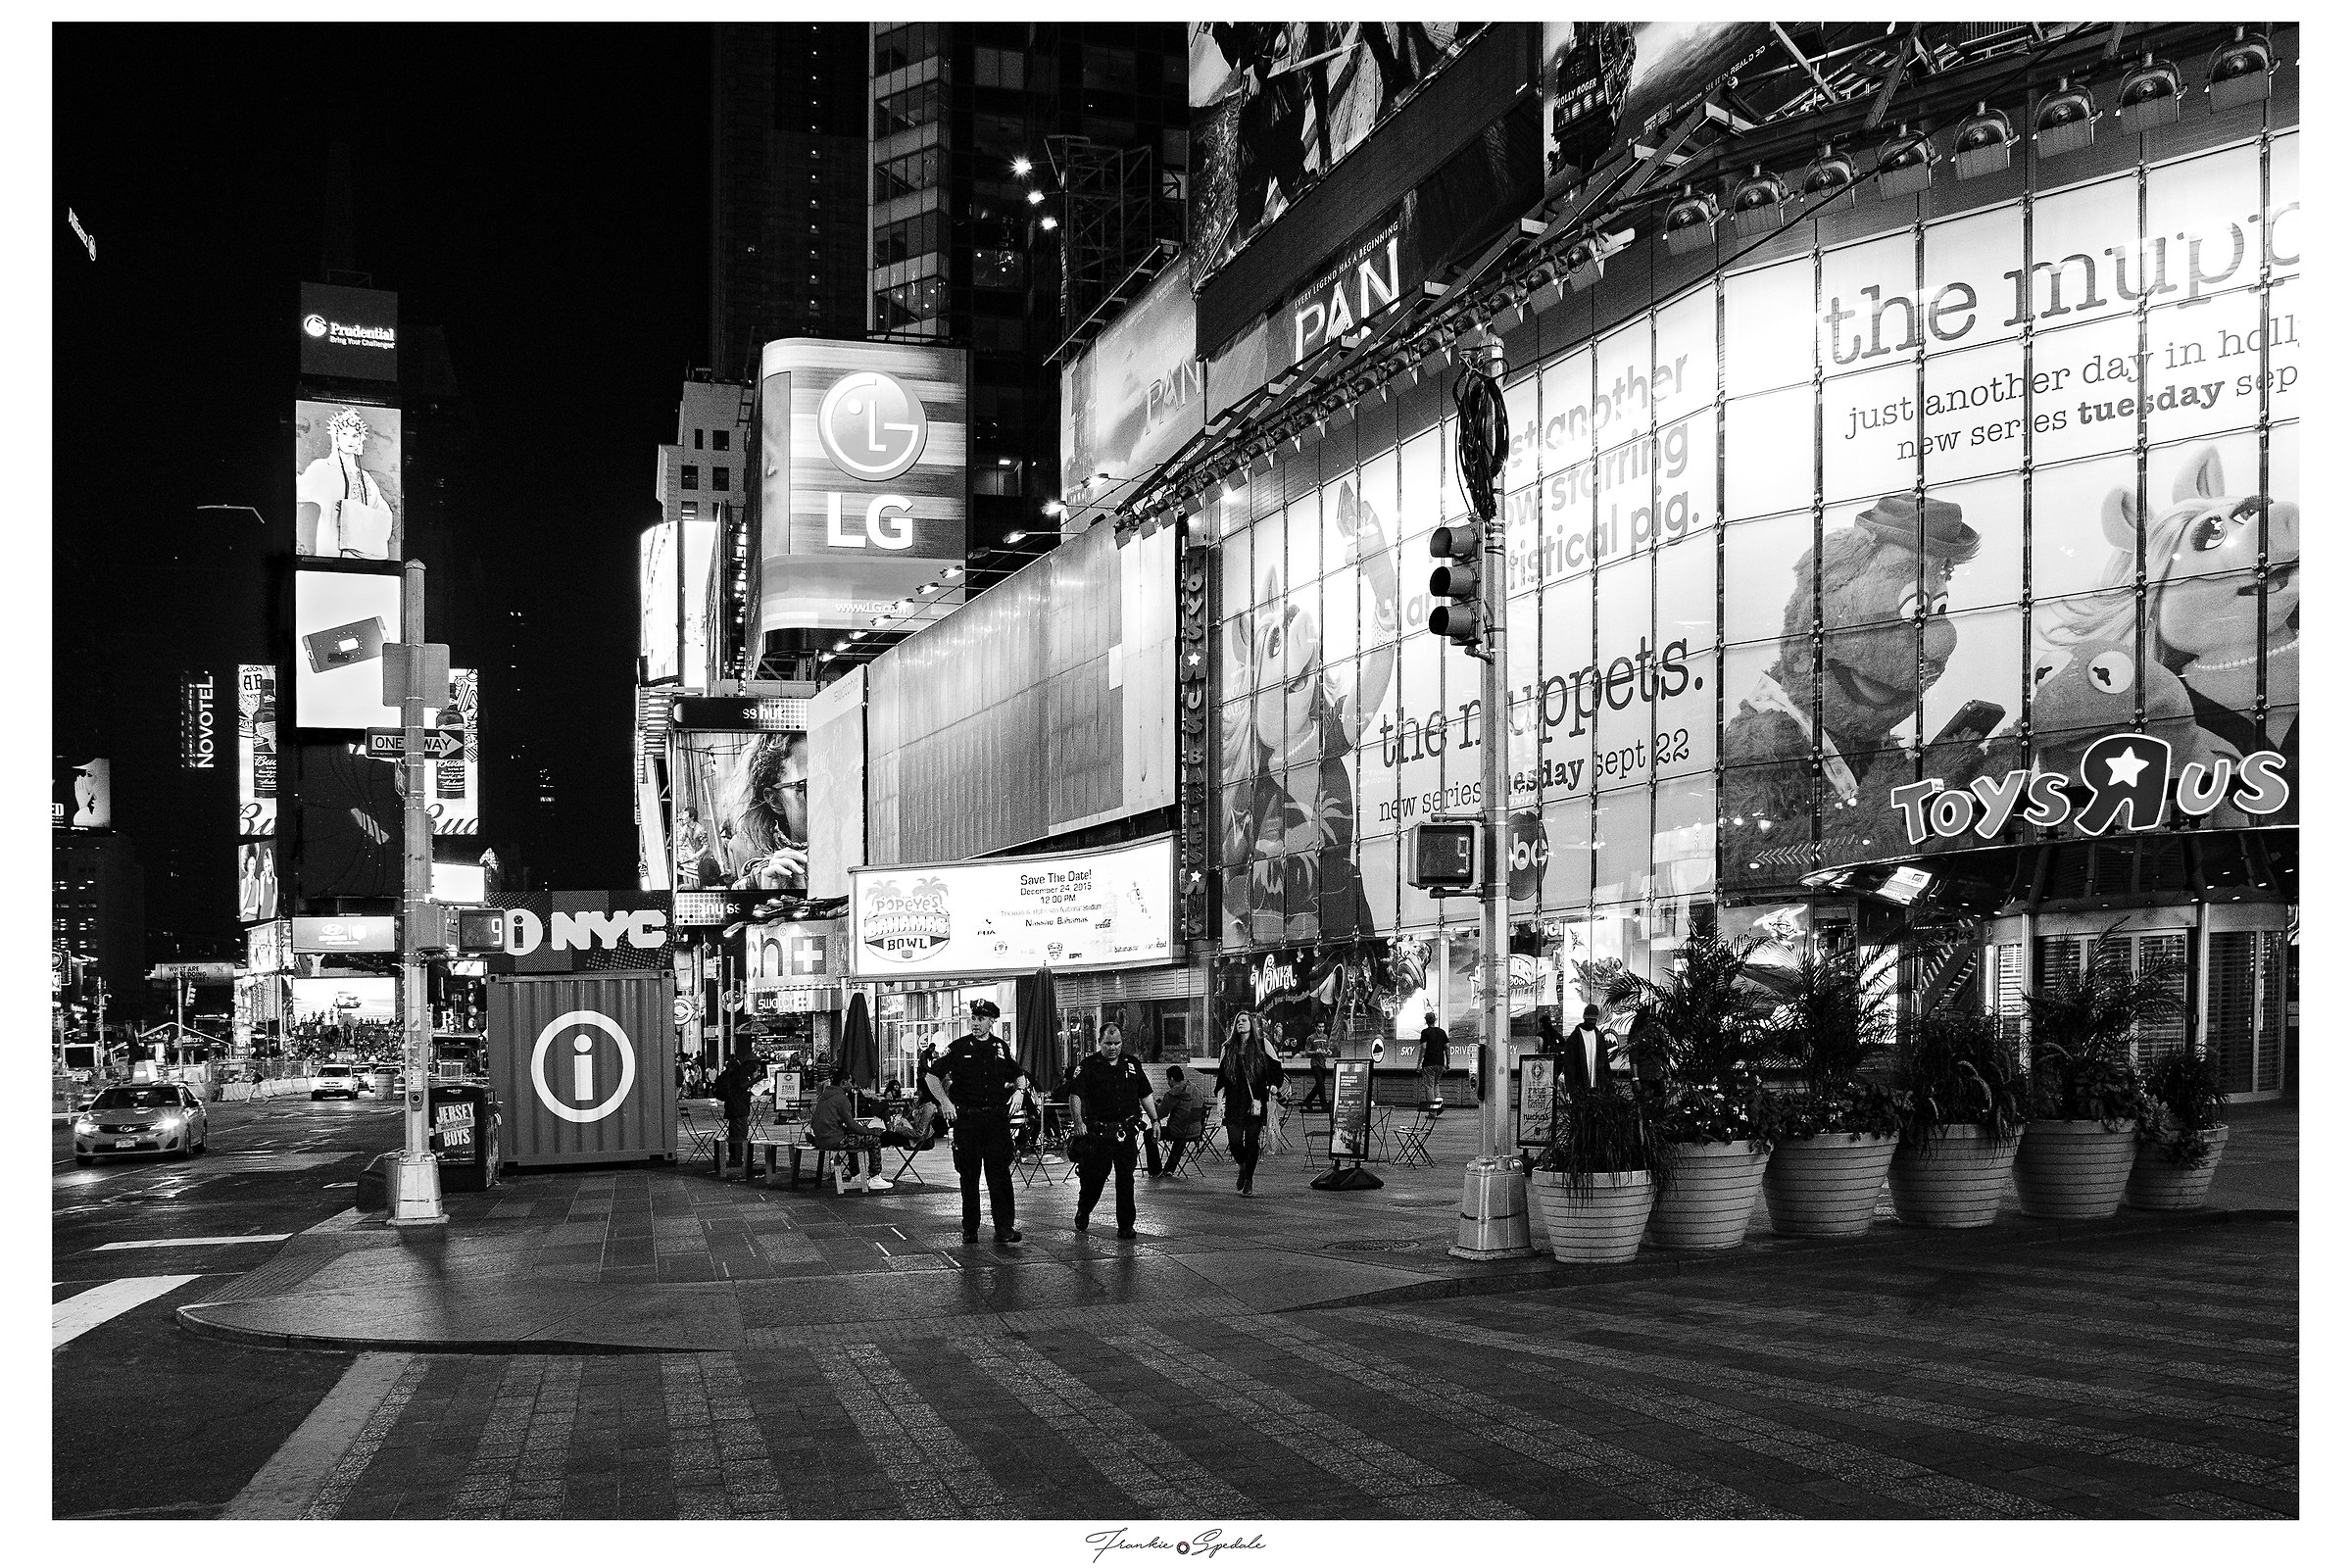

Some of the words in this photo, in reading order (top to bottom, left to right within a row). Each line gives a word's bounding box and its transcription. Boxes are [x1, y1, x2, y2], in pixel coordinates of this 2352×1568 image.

[1557, 89, 1576, 109] JOLLY
[1577, 77, 1597, 96] ROGER
[1295, 288, 1312, 309] EVERY
[1313, 270, 1338, 295] LEGEND
[1339, 257, 1351, 274] HAS
[1352, 254, 1357, 264] A
[1359, 220, 1398, 259] BEGINNING
[1296, 237, 1400, 370] PAN
[329, 321, 395, 342] Prudential
[1823, 281, 1978, 366] the
[329, 335, 347, 346] Bring
[348, 337, 362, 346] Your
[1845, 396, 1914, 440] just
[1926, 367, 2071, 416] another
[2082, 355, 2154, 384] day
[2166, 341, 2206, 369] in
[2218, 315, 2298, 359] holl
[1145, 357, 1200, 436] PAN
[1545, 353, 1689, 451] another
[1897, 430, 1962, 461] new
[2078, 379, 2226, 425] tuesday
[2235, 365, 2298, 397] sep
[1551, 422, 1689, 513] starring
[827, 491, 914, 551] LG
[1507, 504, 1618, 591] tistical
[1631, 485, 1699, 560] pig.
[835, 602, 908, 615] www.LG.com
[760, 704, 785, 719] hut
[375, 737, 404, 750] ONE
[424, 738, 452, 751] WAY
[1380, 707, 1447, 767] the
[1379, 796, 1417, 822] new
[1422, 781, 1481, 814] series
[1595, 740, 1646, 778] sept
[1655, 728, 1690, 766] 22
[2177, 750, 2290, 816] US
[1457, 836, 1470, 874] 9
[1020, 874, 1046, 886] Save
[1048, 872, 1066, 884] The
[1068, 869, 1092, 882] Date!
[1020, 886, 1057, 896] December
[1073, 882, 1092, 892] 2015
[1063, 894, 1076, 903] PM
[492, 917, 503, 945] 9
[551, 909, 667, 951] NYC
[864, 914, 948, 938] BAHAMAS
[1056, 916, 1089, 925] Bahamas
[887, 938, 927, 951] BOWL
[759, 996, 795, 1010] swatch
[1400, 1047, 1415, 1056] SKY
[436, 1102, 474, 1124] JERSEY
[443, 1128, 470, 1147] BOYS
